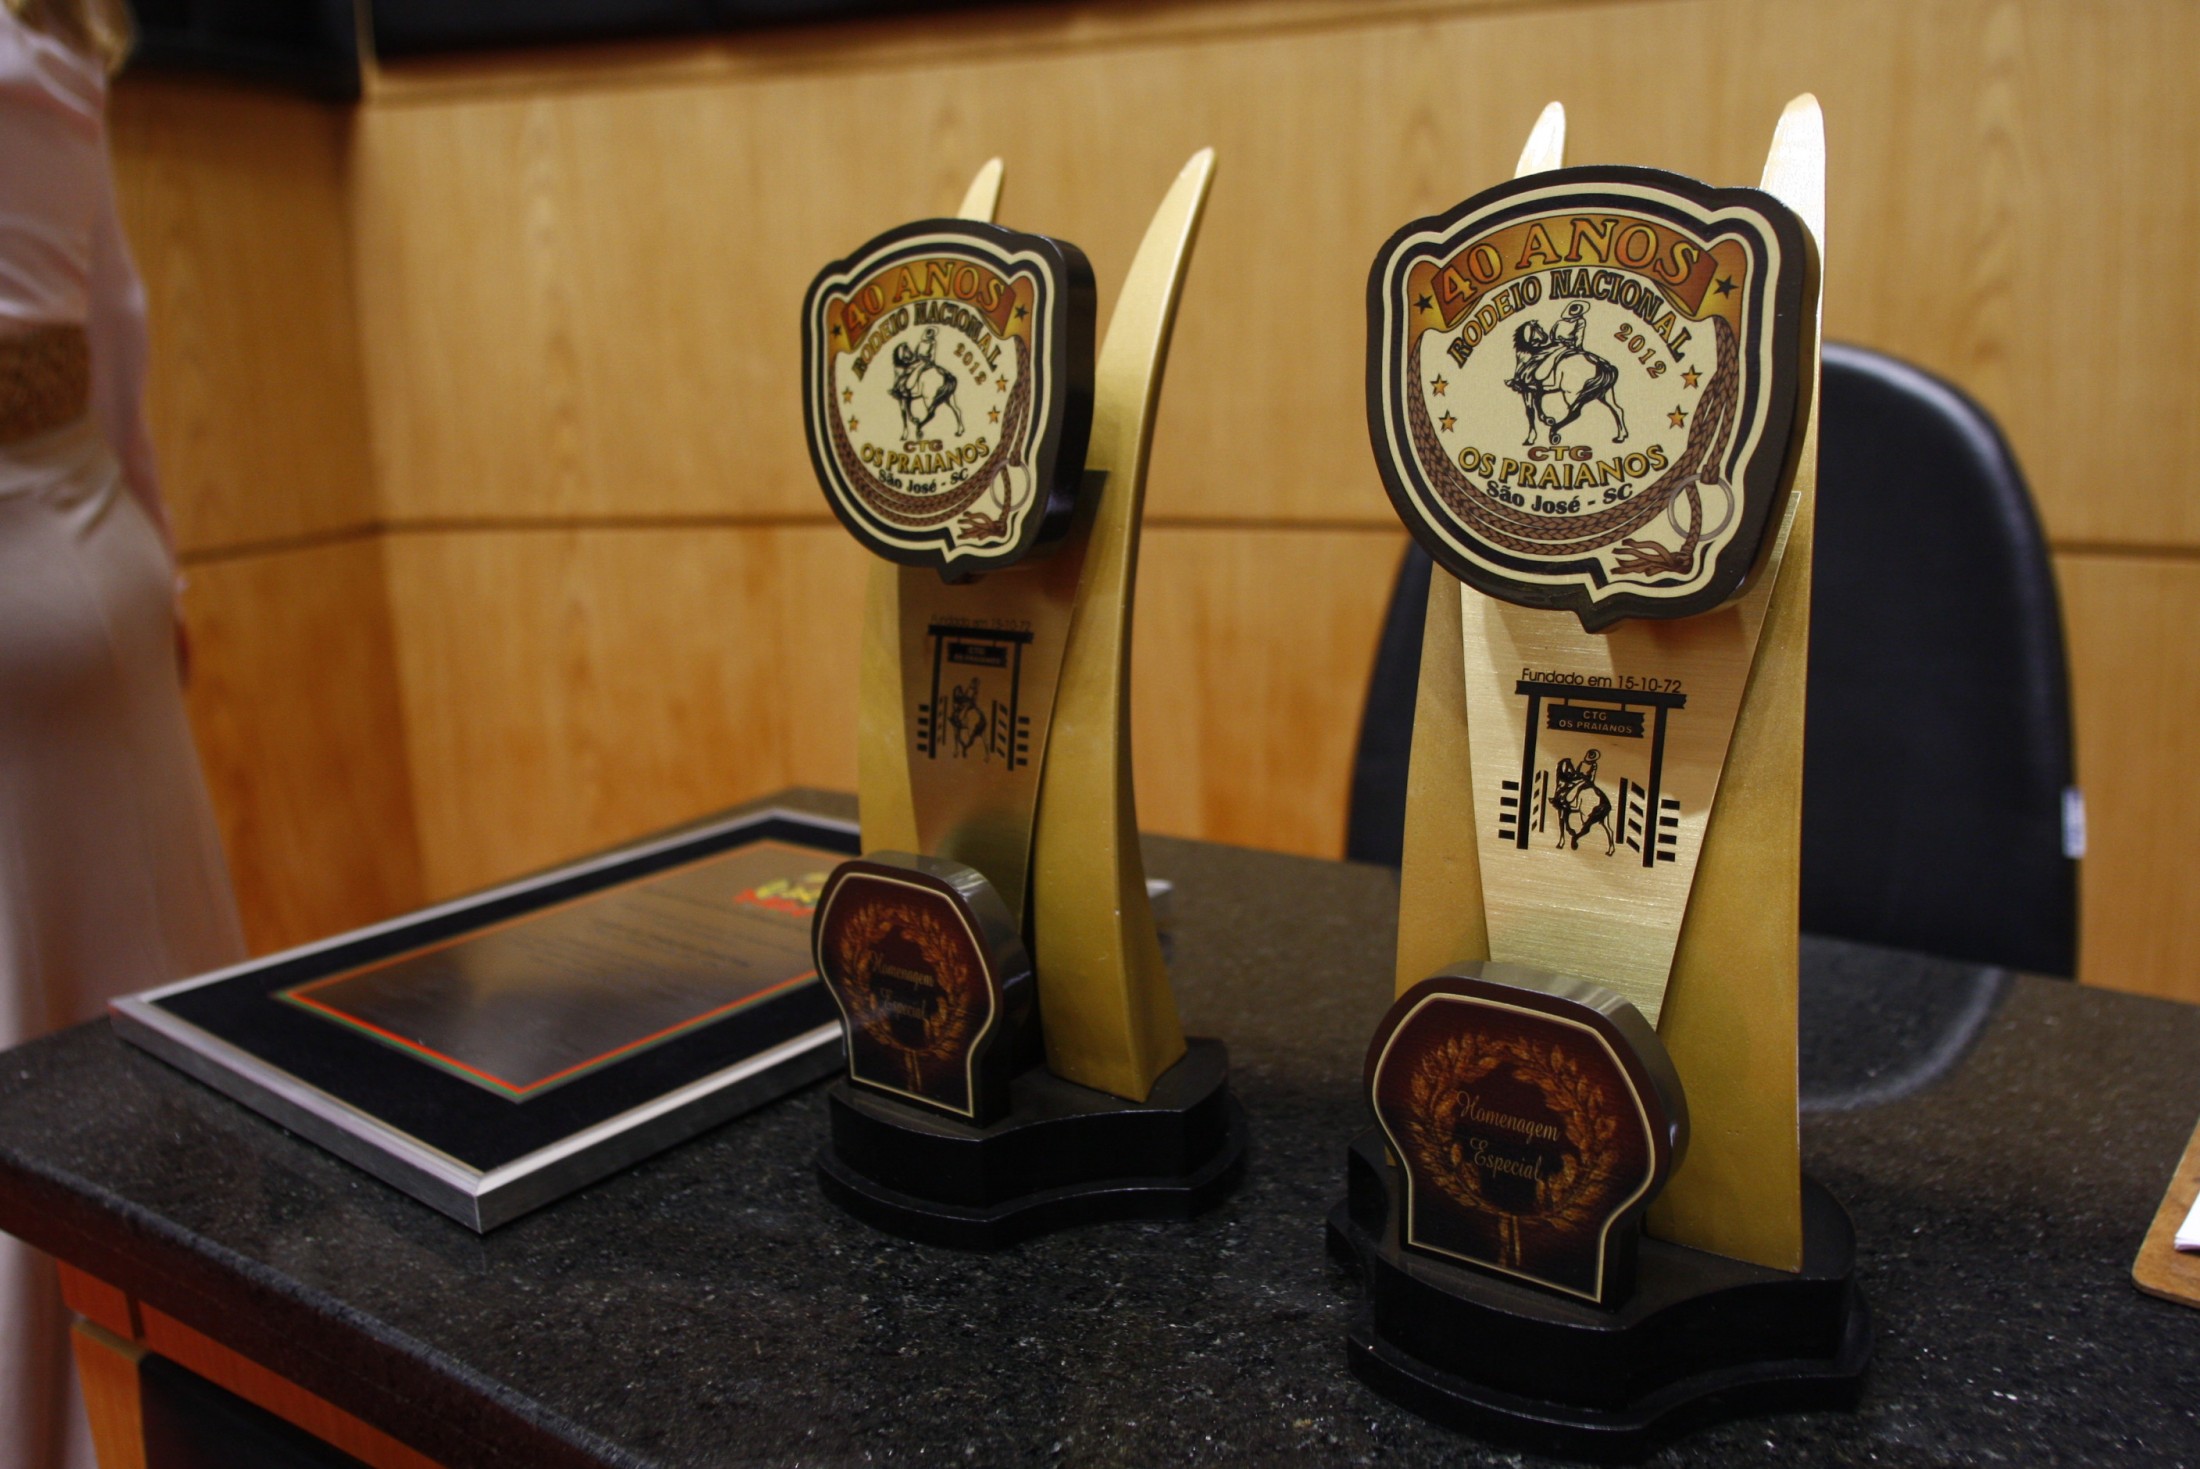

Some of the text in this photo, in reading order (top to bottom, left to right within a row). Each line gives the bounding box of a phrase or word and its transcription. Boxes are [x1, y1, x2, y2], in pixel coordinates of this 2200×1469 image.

[1443, 217, 1700, 304] 40 ANOS
[844, 263, 1005, 330] 40 ANOS
[1446, 269, 1692, 369] RODEIO NACIONAL
[851, 301, 1002, 381] RODEIO NACIONAL
[950, 341, 988, 386] 2012
[1613, 322, 1667, 379] 2012
[861, 436, 990, 474] OS PRAIANOS
[903, 439, 943, 453] CTG
[1458, 444, 1669, 490] OS PRAIANOS
[1528, 445, 1593, 461] CTG
[878, 469, 903, 490] São
[906, 478, 937, 494] José
[950, 468, 969, 485] SC
[1486, 480, 1525, 508] São
[1531, 494, 1581, 514] José
[1603, 483, 1634, 505] SC
[1522, 668, 1682, 694] Fundado em 15-10-72
[1558, 719, 1633, 734] OS PRAIANOS
[1583, 710, 1608, 721] CTG
[1457, 1090, 1560, 1144] Homenagem
[1470, 1137, 1543, 1182] Especial
